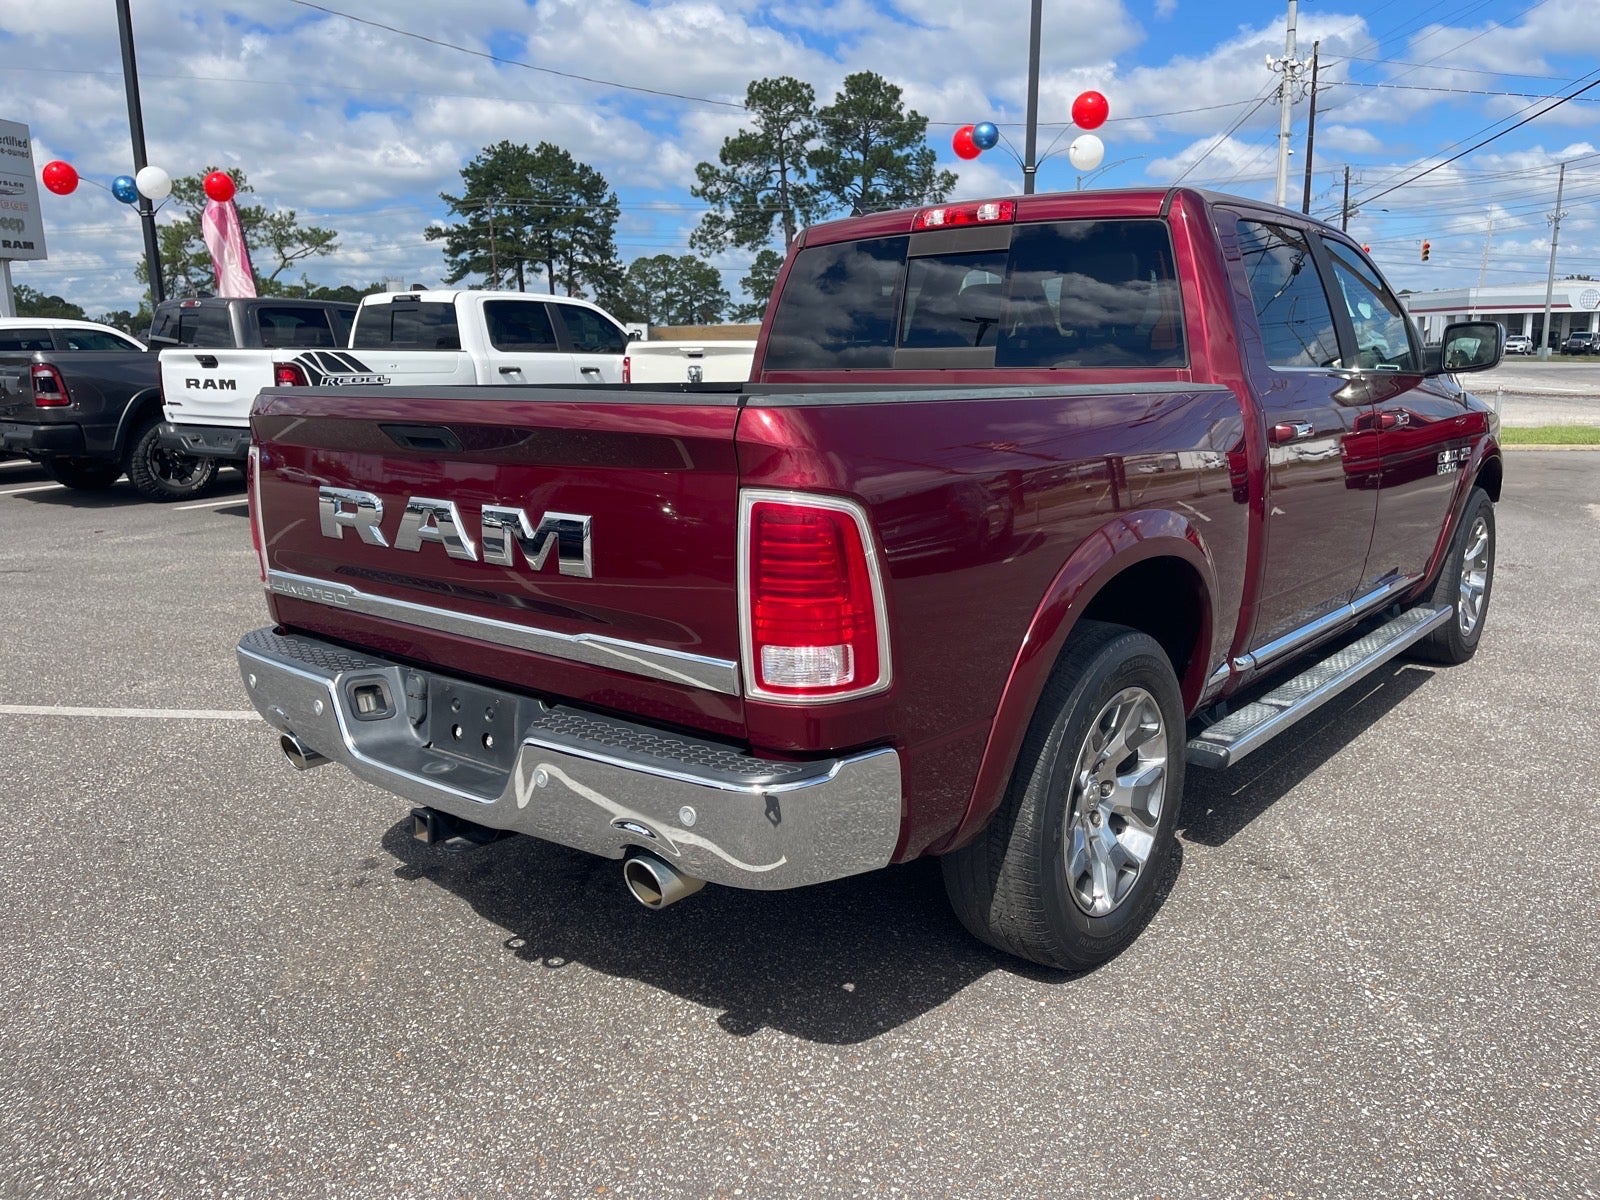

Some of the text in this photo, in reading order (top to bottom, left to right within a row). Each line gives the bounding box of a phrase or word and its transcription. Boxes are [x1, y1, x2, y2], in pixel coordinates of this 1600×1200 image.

[2, 239, 34, 250] RAM
[185, 378, 237, 390] RAM
[320, 376, 390, 387] REBEL
[318, 485, 593, 578] RAM
[271, 580, 347, 604] LIMITED
